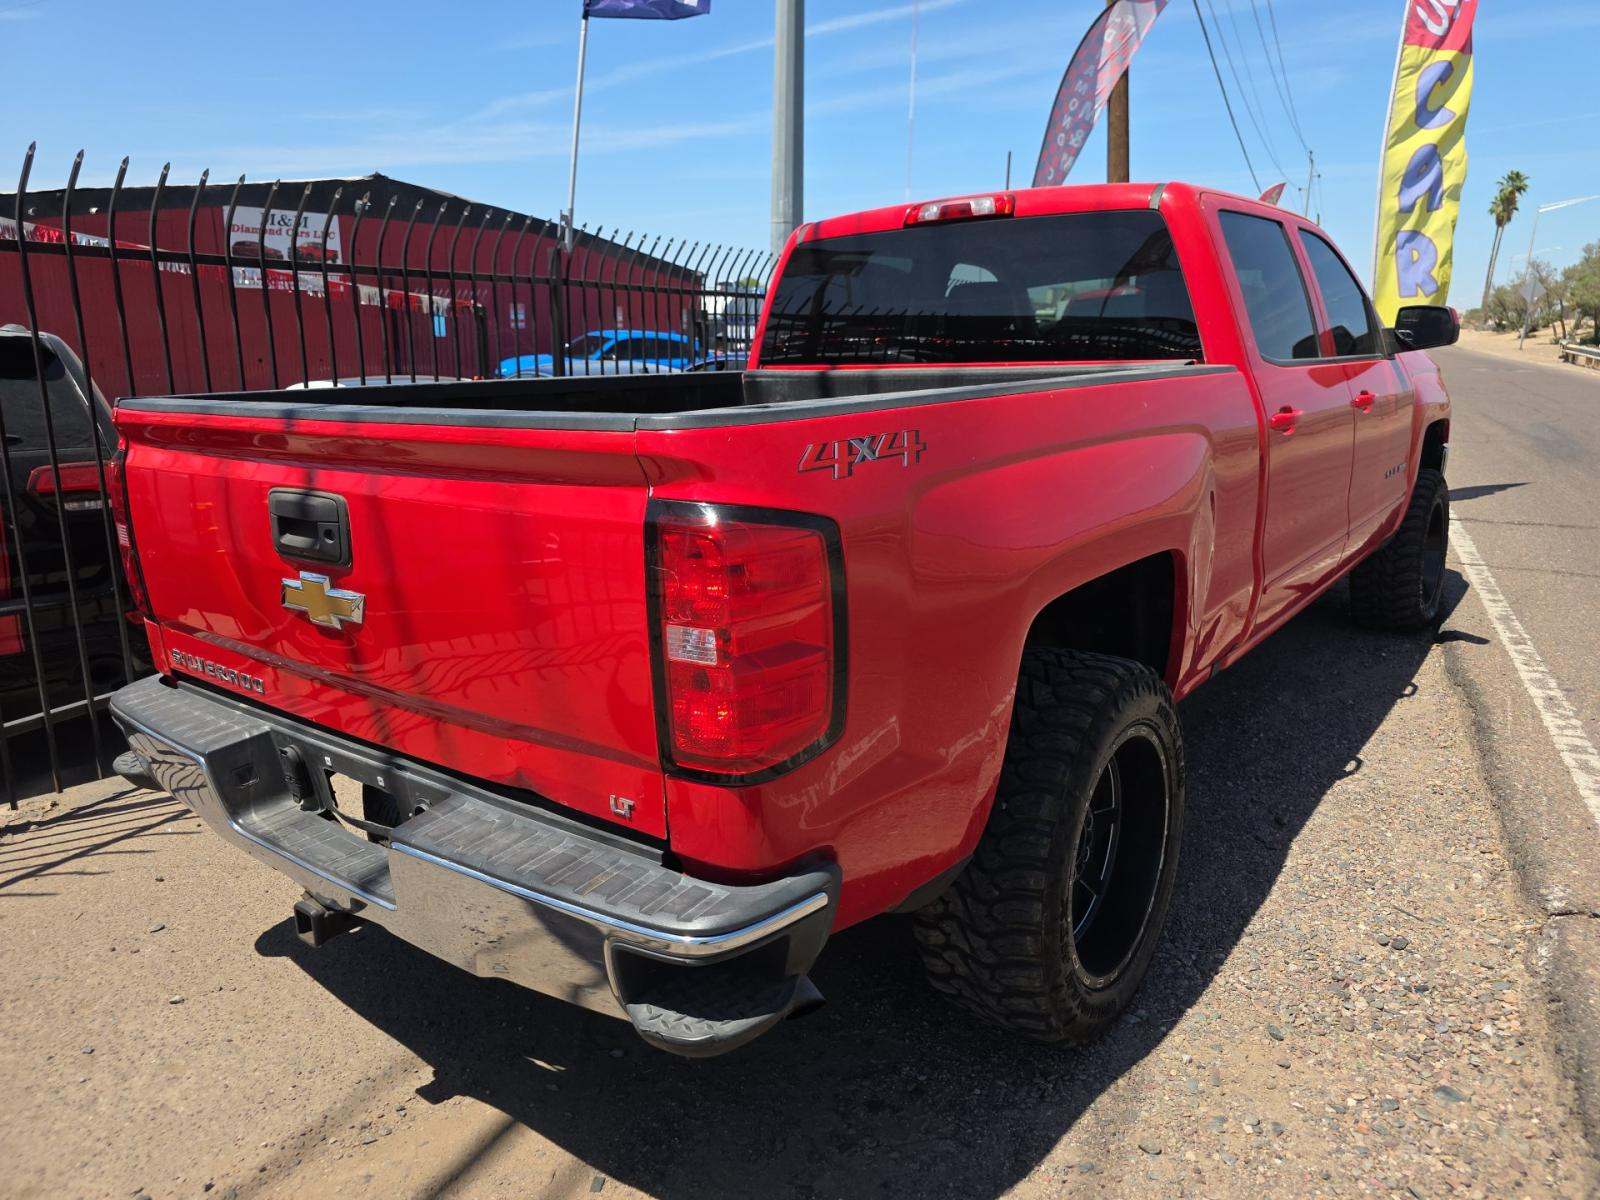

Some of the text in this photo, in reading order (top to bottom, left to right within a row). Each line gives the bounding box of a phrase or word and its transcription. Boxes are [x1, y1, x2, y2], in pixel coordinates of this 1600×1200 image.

[1394, 60, 1457, 299] CAR
[286, 227, 311, 239] Crs
[313, 230, 336, 240] LC
[171, 647, 266, 695] SILVERADO
[608, 794, 636, 822] LT
